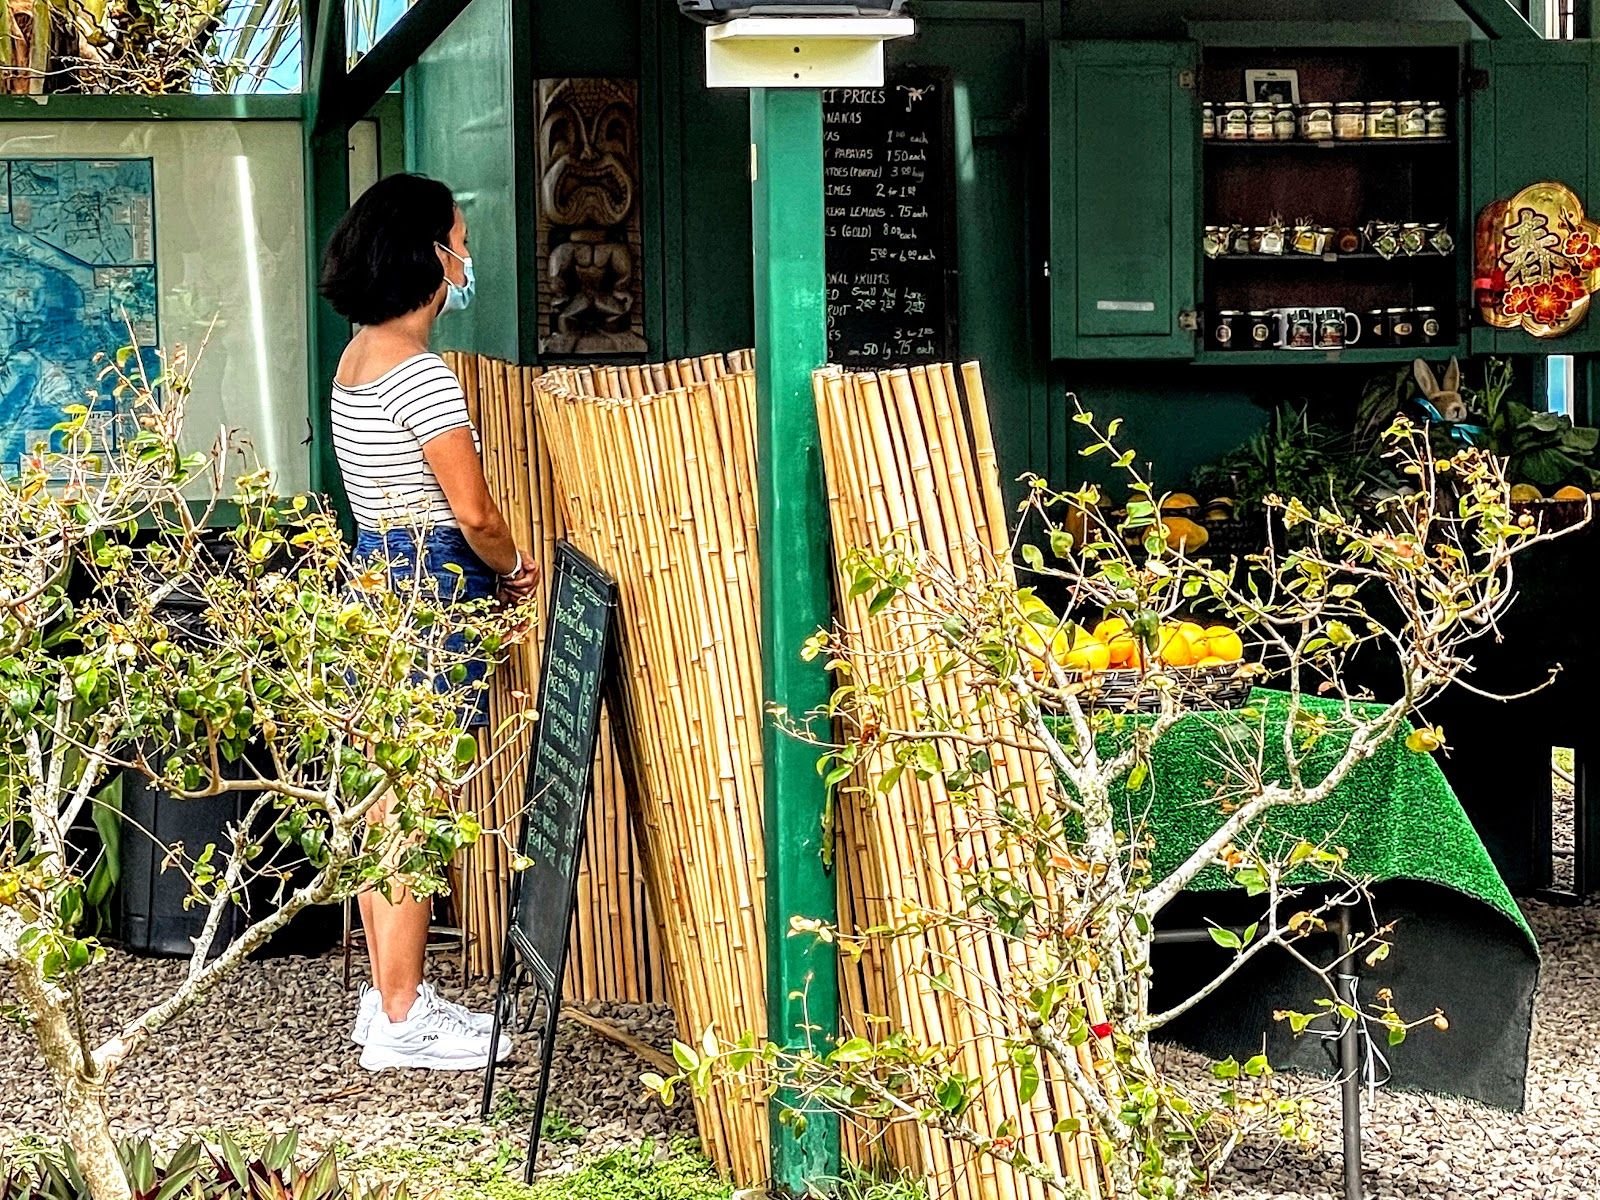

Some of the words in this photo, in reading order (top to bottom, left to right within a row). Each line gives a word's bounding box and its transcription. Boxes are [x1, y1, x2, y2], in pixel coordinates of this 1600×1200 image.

[842, 89, 886, 104] PRICES
[876, 183, 886, 198] 2
[850, 207, 886, 218] LEMONS
[842, 224, 872, 238] (GOLD)
[1502, 208, 1571, 285] 春
